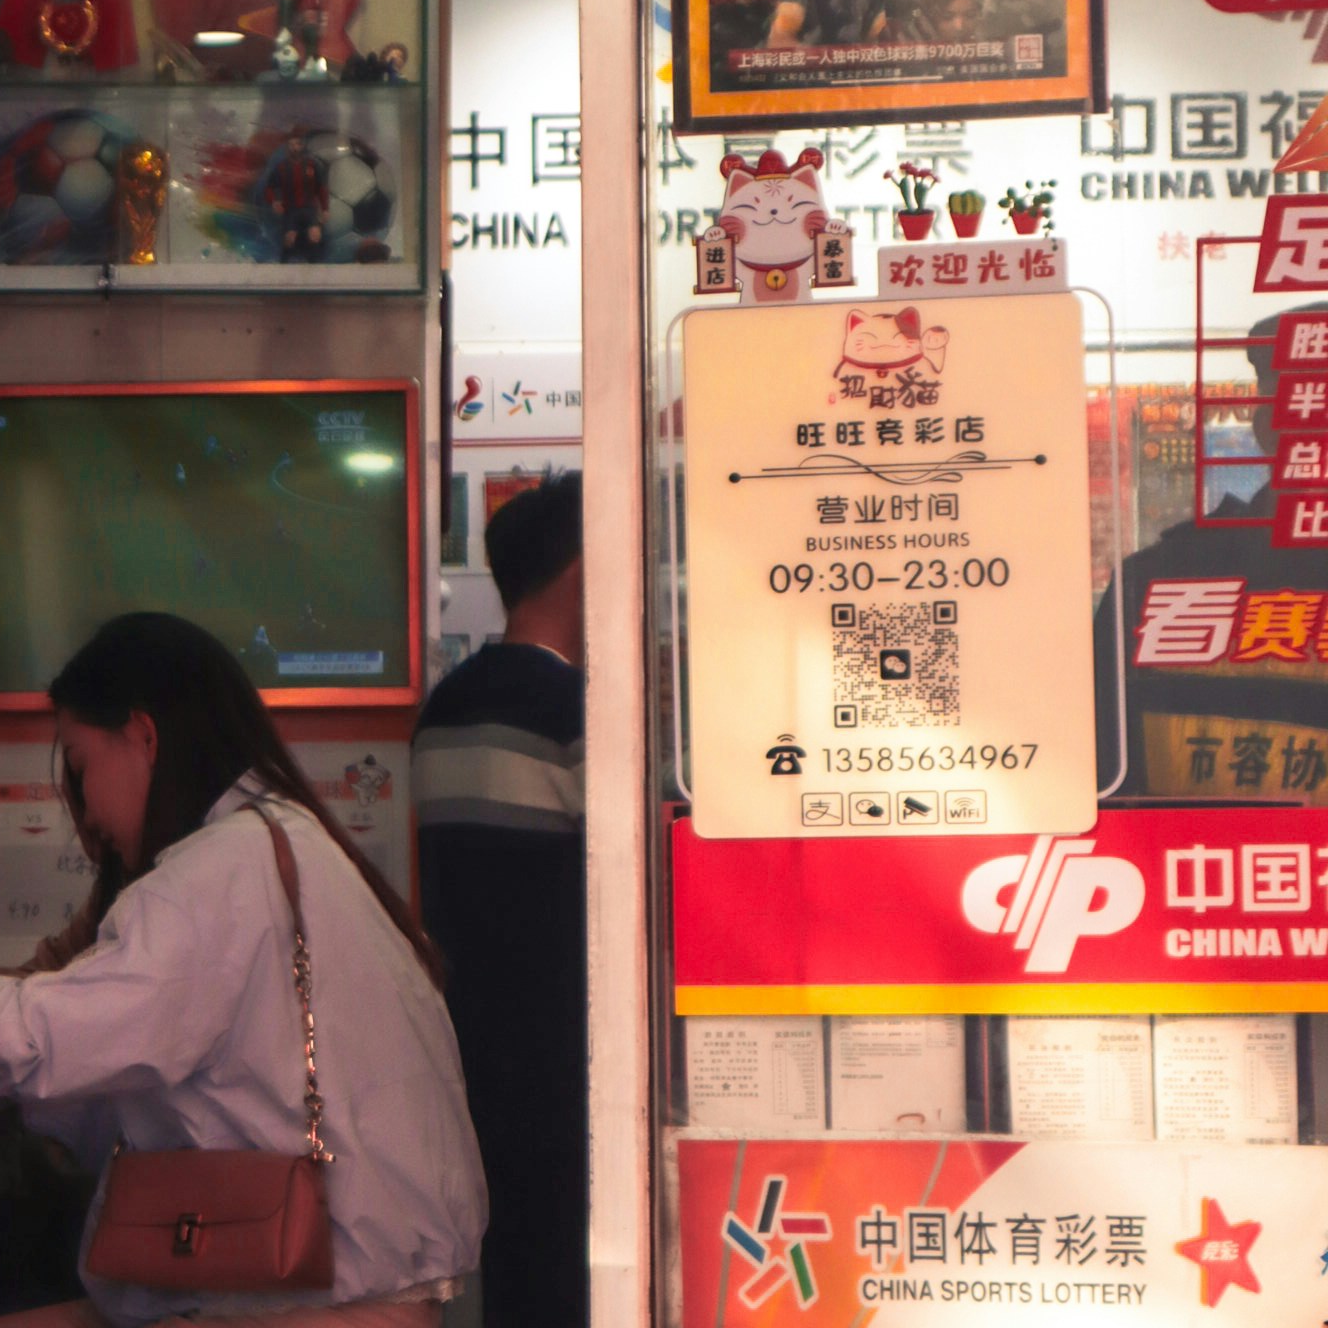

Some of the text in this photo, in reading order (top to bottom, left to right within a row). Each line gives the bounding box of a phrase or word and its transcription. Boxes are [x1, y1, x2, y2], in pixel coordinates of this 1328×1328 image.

[1080, 170, 1216, 201] CHINA
[451, 212, 570, 249] CHINA
[705, 246, 727, 286] 进店
[823, 240, 845, 280] 暴富
[889, 246, 1057, 288] 欢迎光临
[546, 390, 582, 408] 中国
[796, 415, 986, 448] 旺旺竞彩店
[816, 492, 960, 525] 营业时间
[806, 532, 971, 552] BUSINESS HOURS
[822, 743, 1040, 773] 13585634967
[1165, 928, 1283, 958] CHINA
[858, 1209, 1148, 1267] 中国体育彩票
[862, 1279, 1148, 1306] CHINA SPORTS LOTTERY
